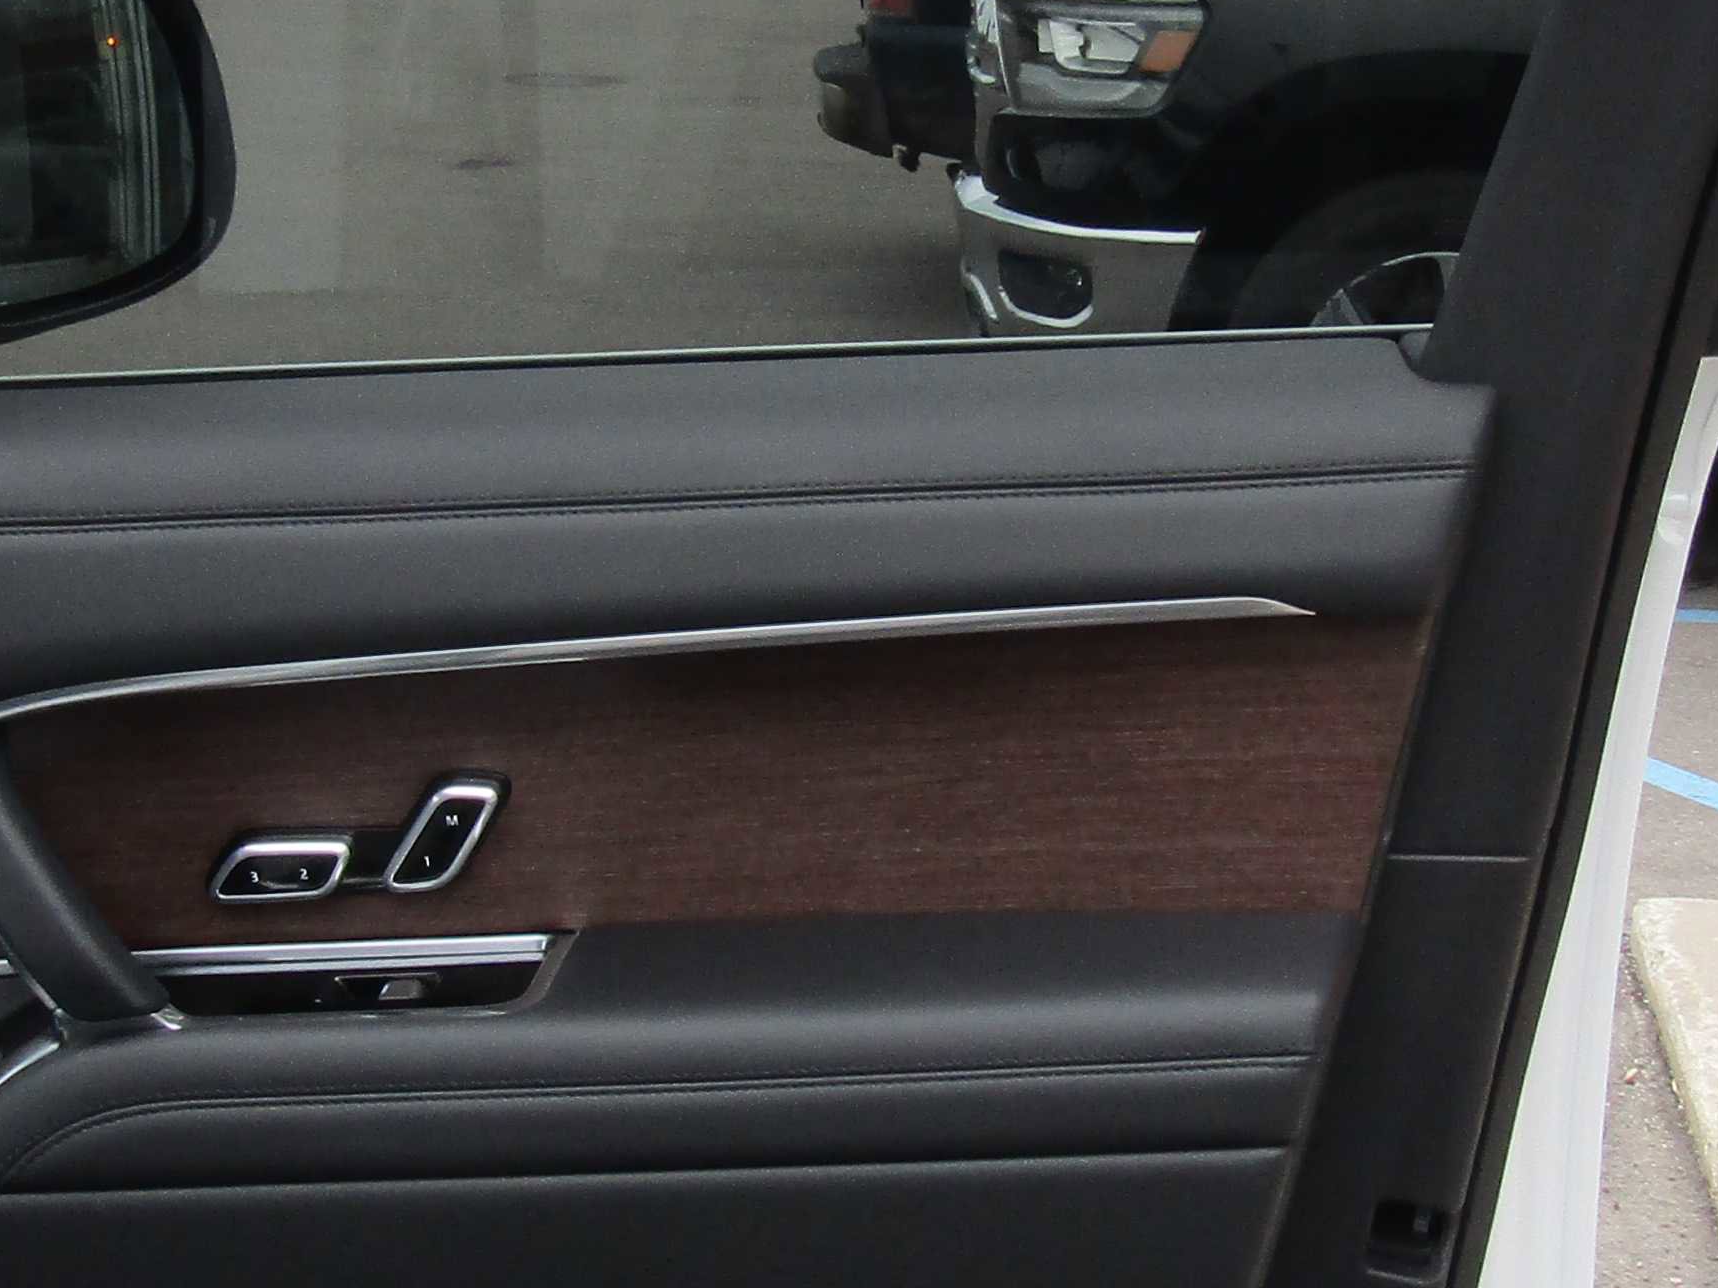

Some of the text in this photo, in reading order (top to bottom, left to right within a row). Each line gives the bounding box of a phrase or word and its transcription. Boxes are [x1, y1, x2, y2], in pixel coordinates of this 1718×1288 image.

[445, 814, 459, 827] M
[423, 855, 430, 868] 1
[250, 867, 309, 884] 3 2
